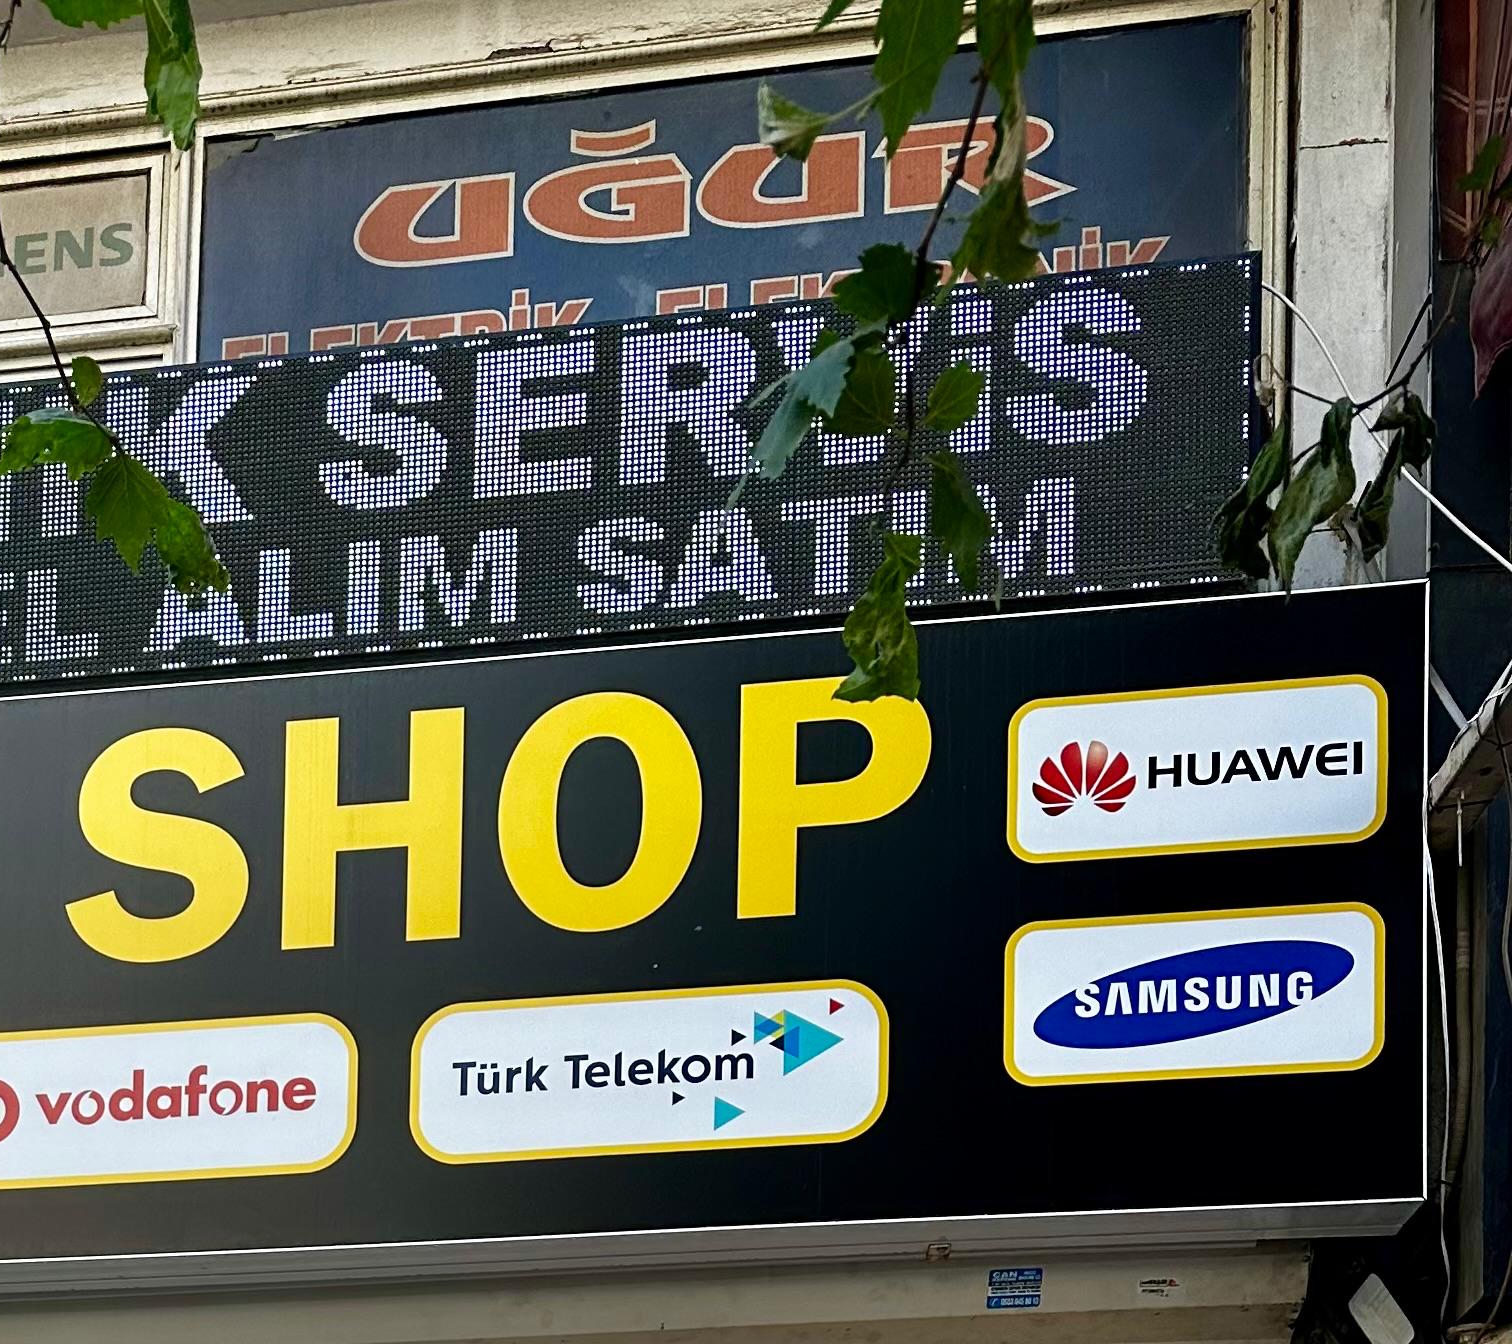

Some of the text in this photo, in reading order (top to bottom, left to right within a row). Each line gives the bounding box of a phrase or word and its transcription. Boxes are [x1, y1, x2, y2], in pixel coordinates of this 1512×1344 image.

[142, 527, 518, 653] ALIM
[1146, 740, 1364, 790] HUAWEI
[64, 675, 933, 965] SHOP
[1074, 970, 1314, 1019] SAMSUNG
[35, 1064, 317, 1126] vodafone
[451, 1046, 755, 1097] Türk Telekom
